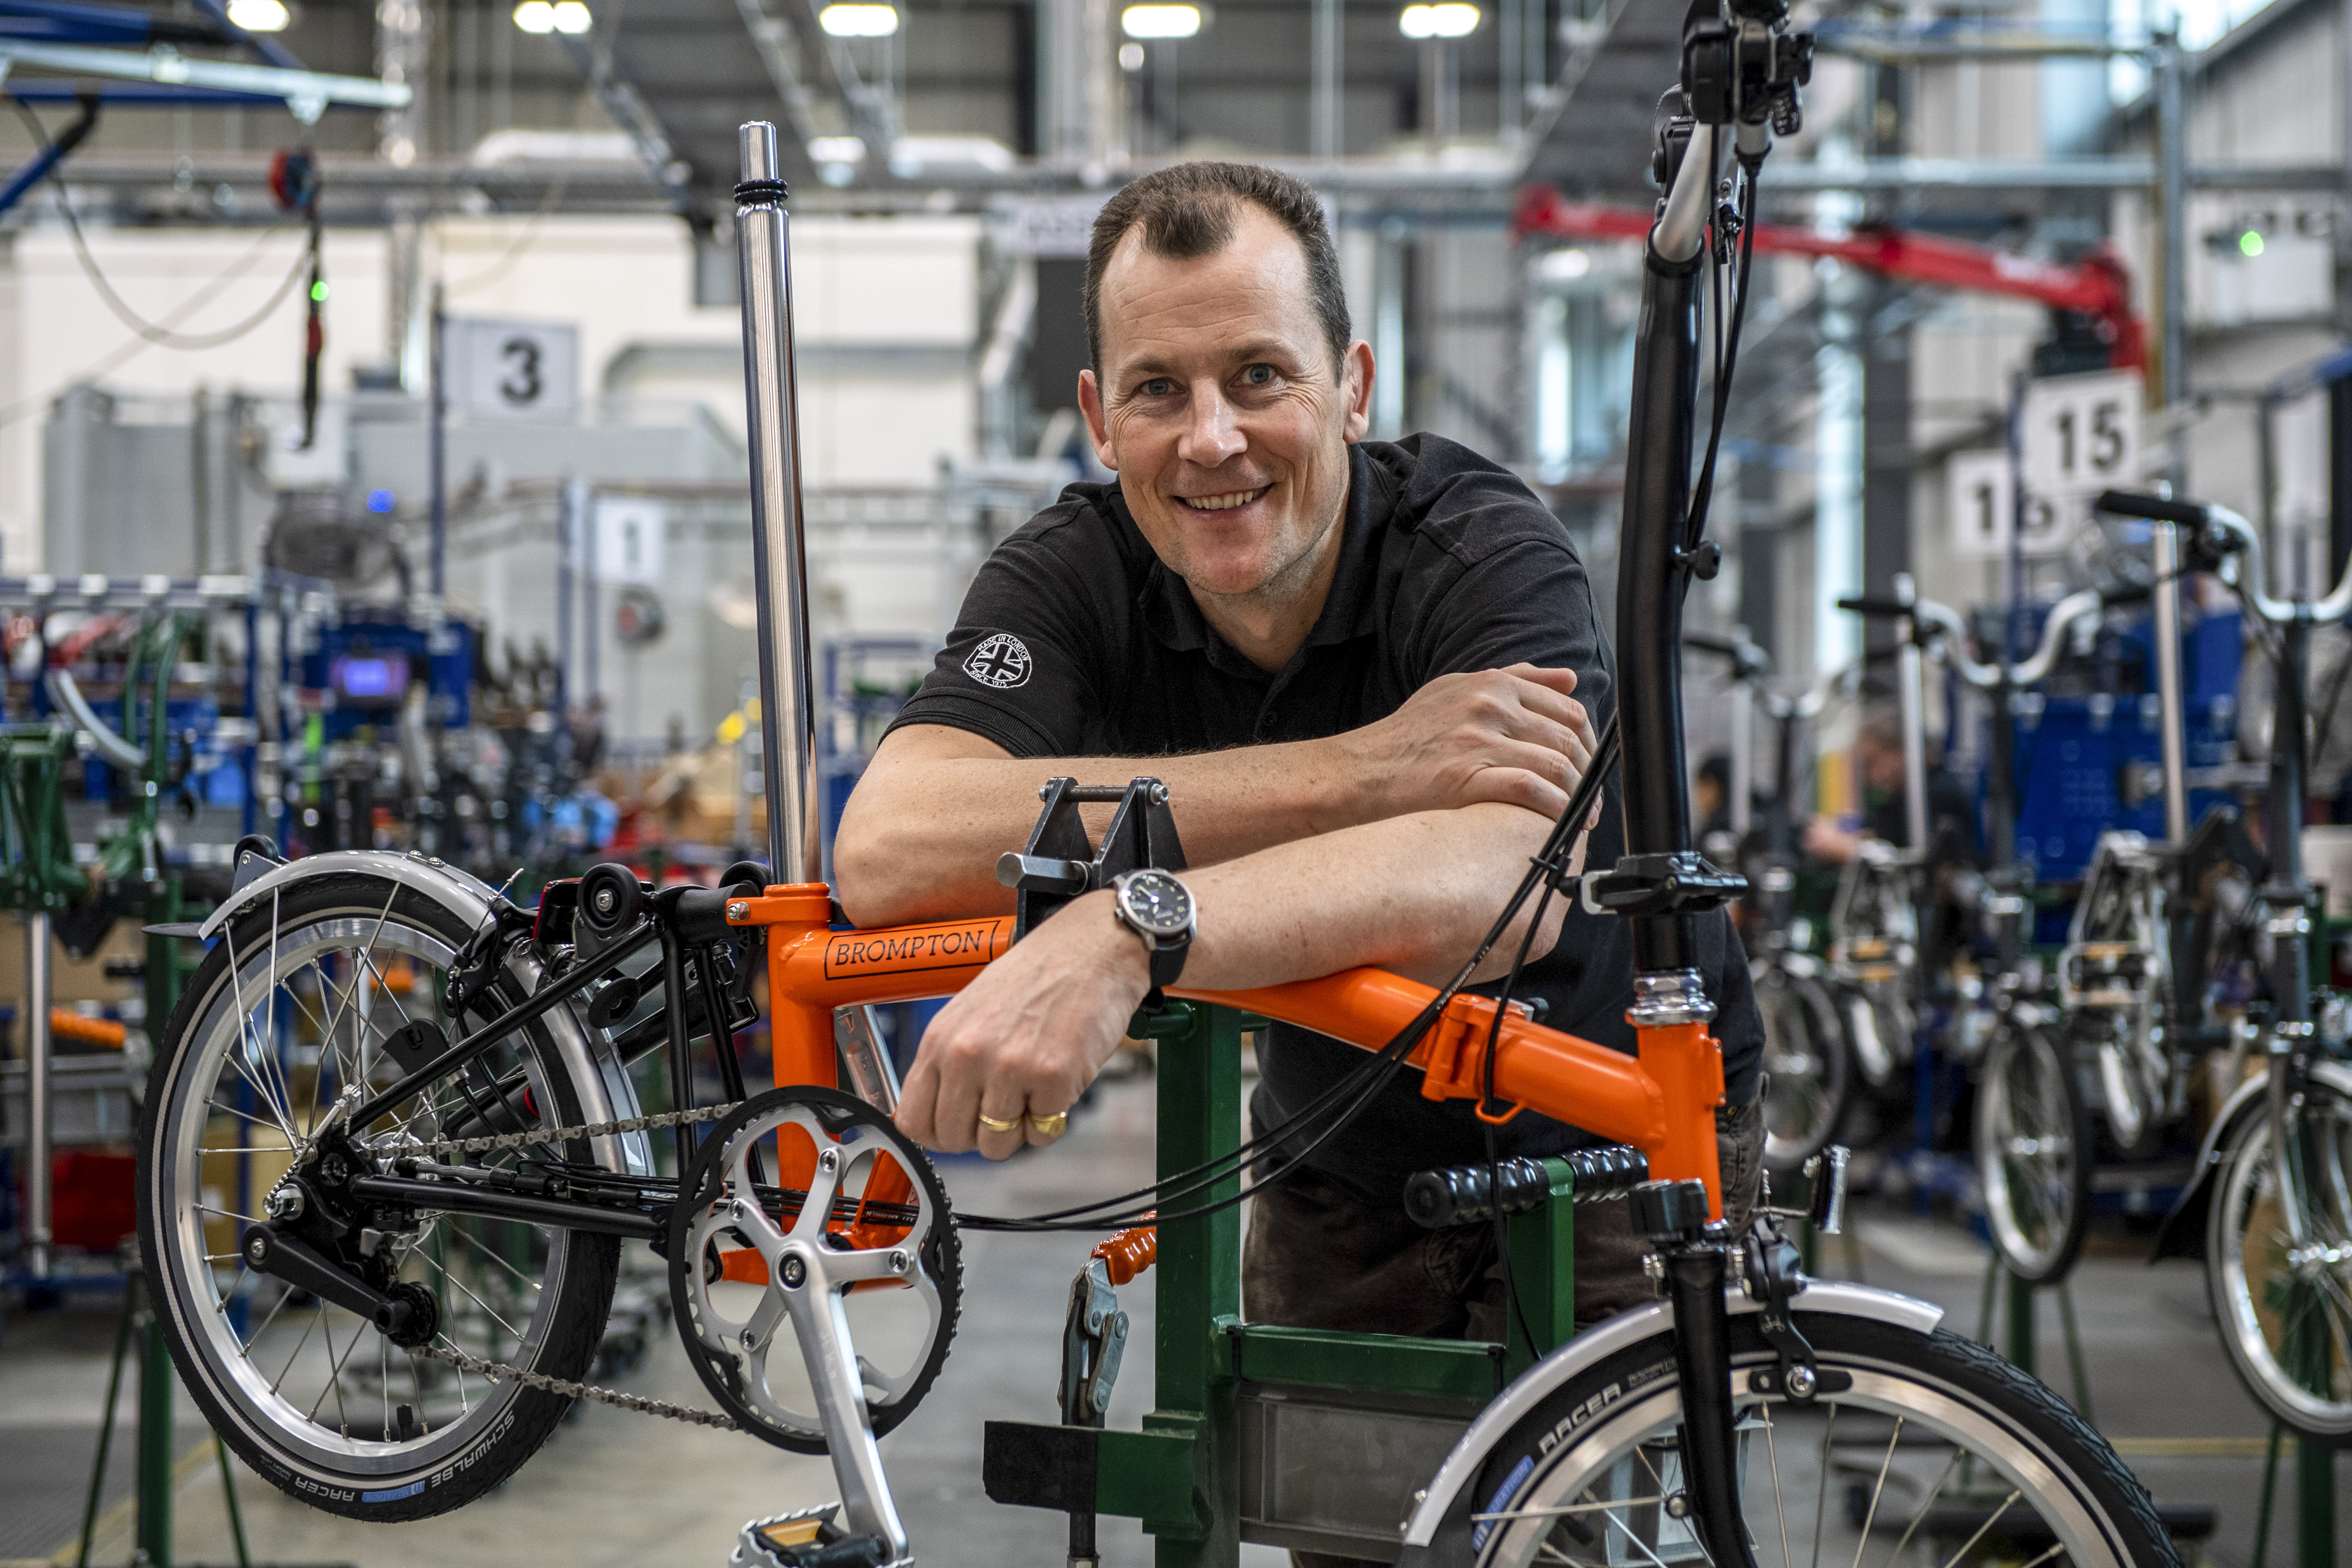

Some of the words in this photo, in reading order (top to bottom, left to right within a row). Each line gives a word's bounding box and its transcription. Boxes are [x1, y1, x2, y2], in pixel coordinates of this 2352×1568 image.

[499, 337, 542, 406] 3
[2055, 401, 2124, 473] 15
[978, 636, 996, 651] MADE
[1007, 636, 1030, 661] LONDON
[970, 670, 988, 683] SINCE
[835, 930, 984, 966] BROMPTON
[1538, 1382, 1622, 1456] RACER
[431, 1410, 515, 1488] SCHWALBE
[294, 1478, 356, 1502] RACER
